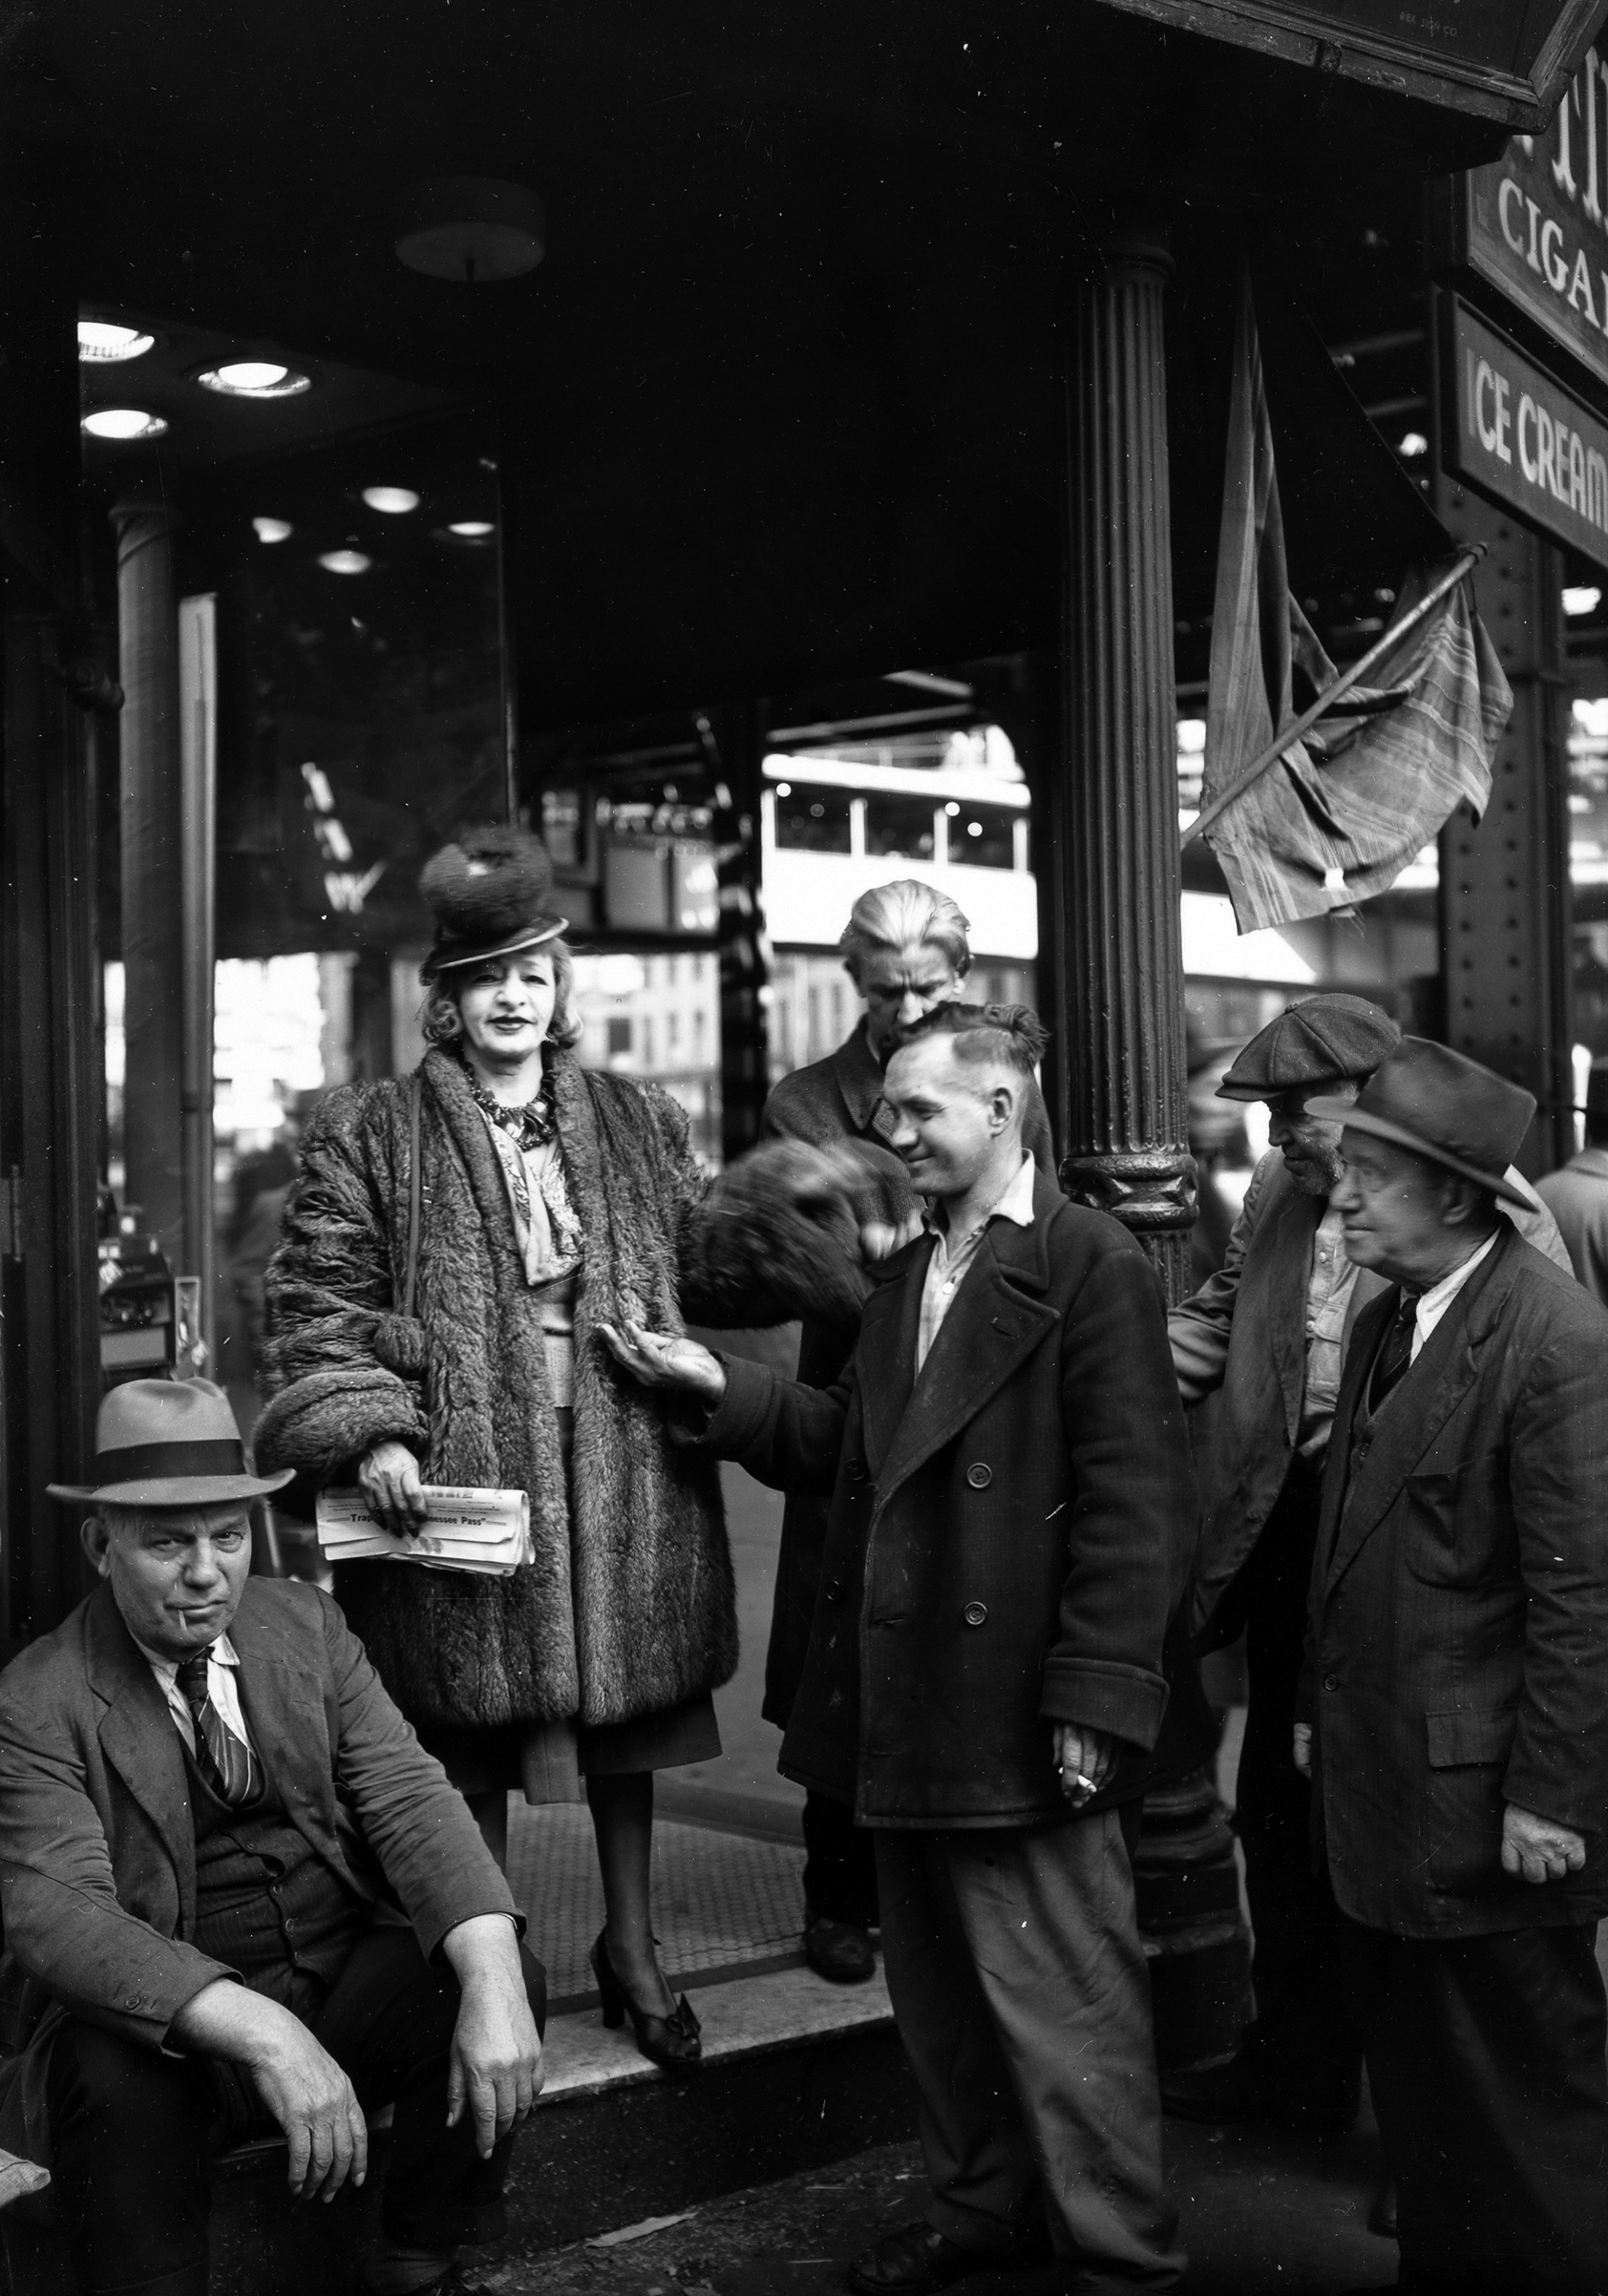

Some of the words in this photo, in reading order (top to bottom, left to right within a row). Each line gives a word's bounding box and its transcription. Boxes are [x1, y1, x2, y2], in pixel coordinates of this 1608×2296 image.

[1400, 11, 1416, 25] REX
[1467, 347, 1512, 465] ICE
[1518, 393, 1608, 536] CREAM
[350, 1513, 373, 1523] Trap
